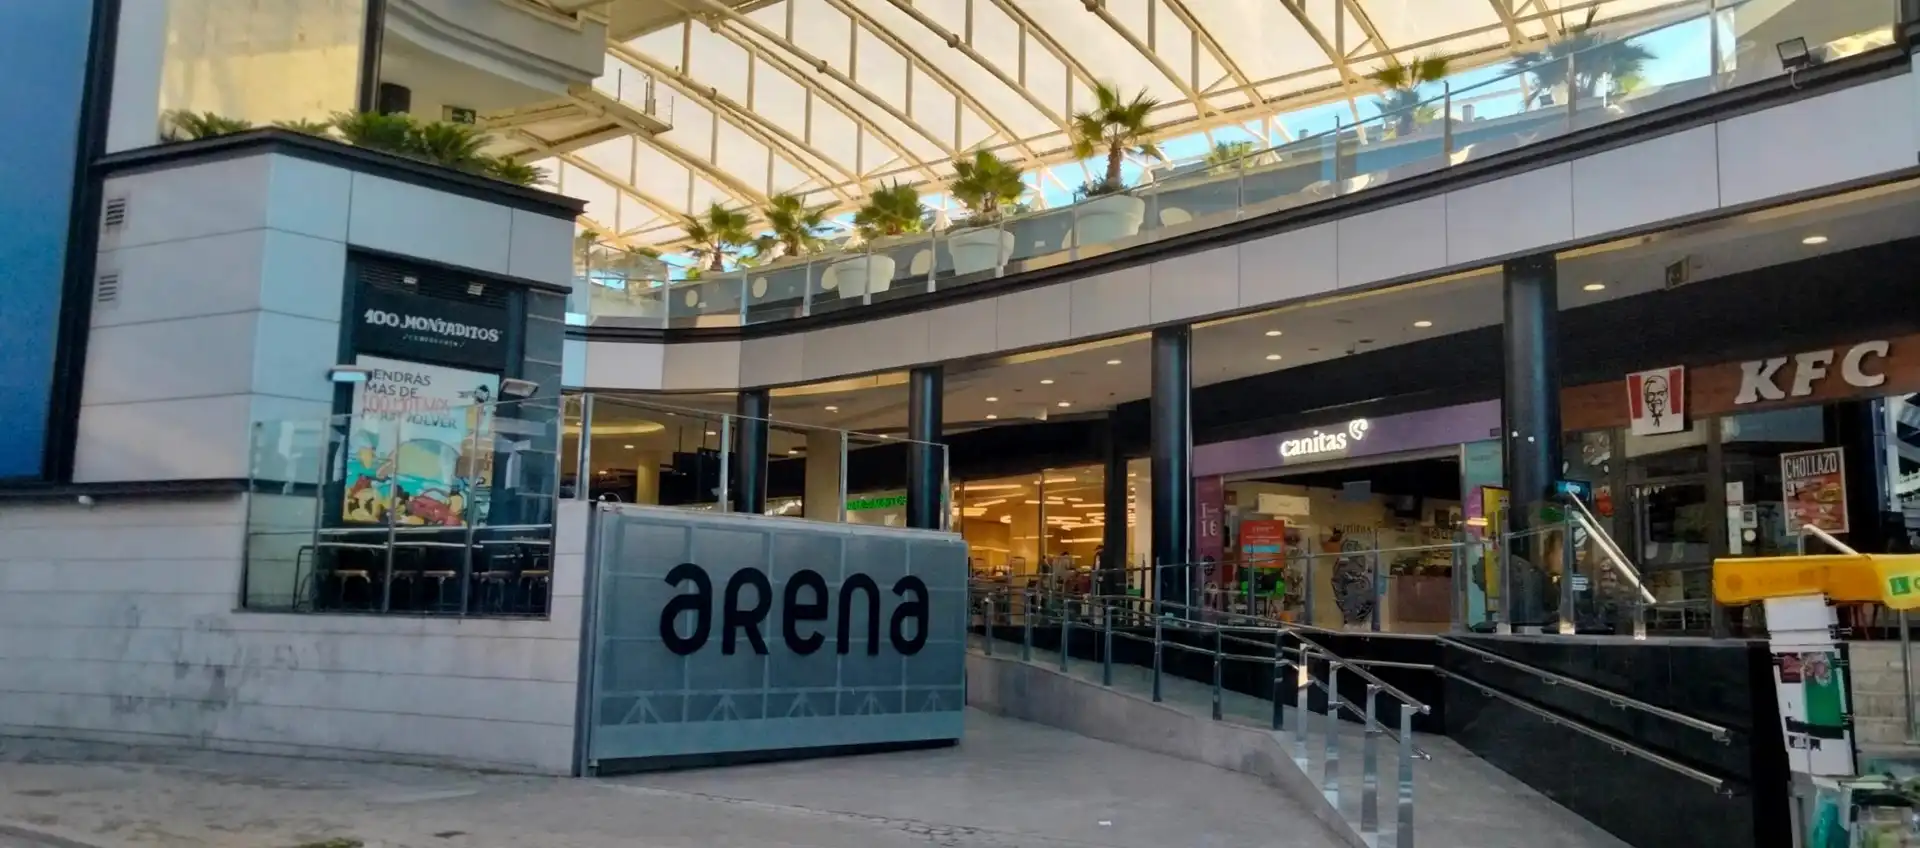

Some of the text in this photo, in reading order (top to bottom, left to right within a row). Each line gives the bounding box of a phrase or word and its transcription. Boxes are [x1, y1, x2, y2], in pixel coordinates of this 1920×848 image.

[364, 308, 400, 327] 100
[400, 314, 500, 342] MONTADITOS
[1734, 339, 1890, 404] KFC
[399, 386, 419, 399] DE
[1280, 430, 1347, 457] canitas
[1785, 452, 1838, 478] CHOLLAZO
